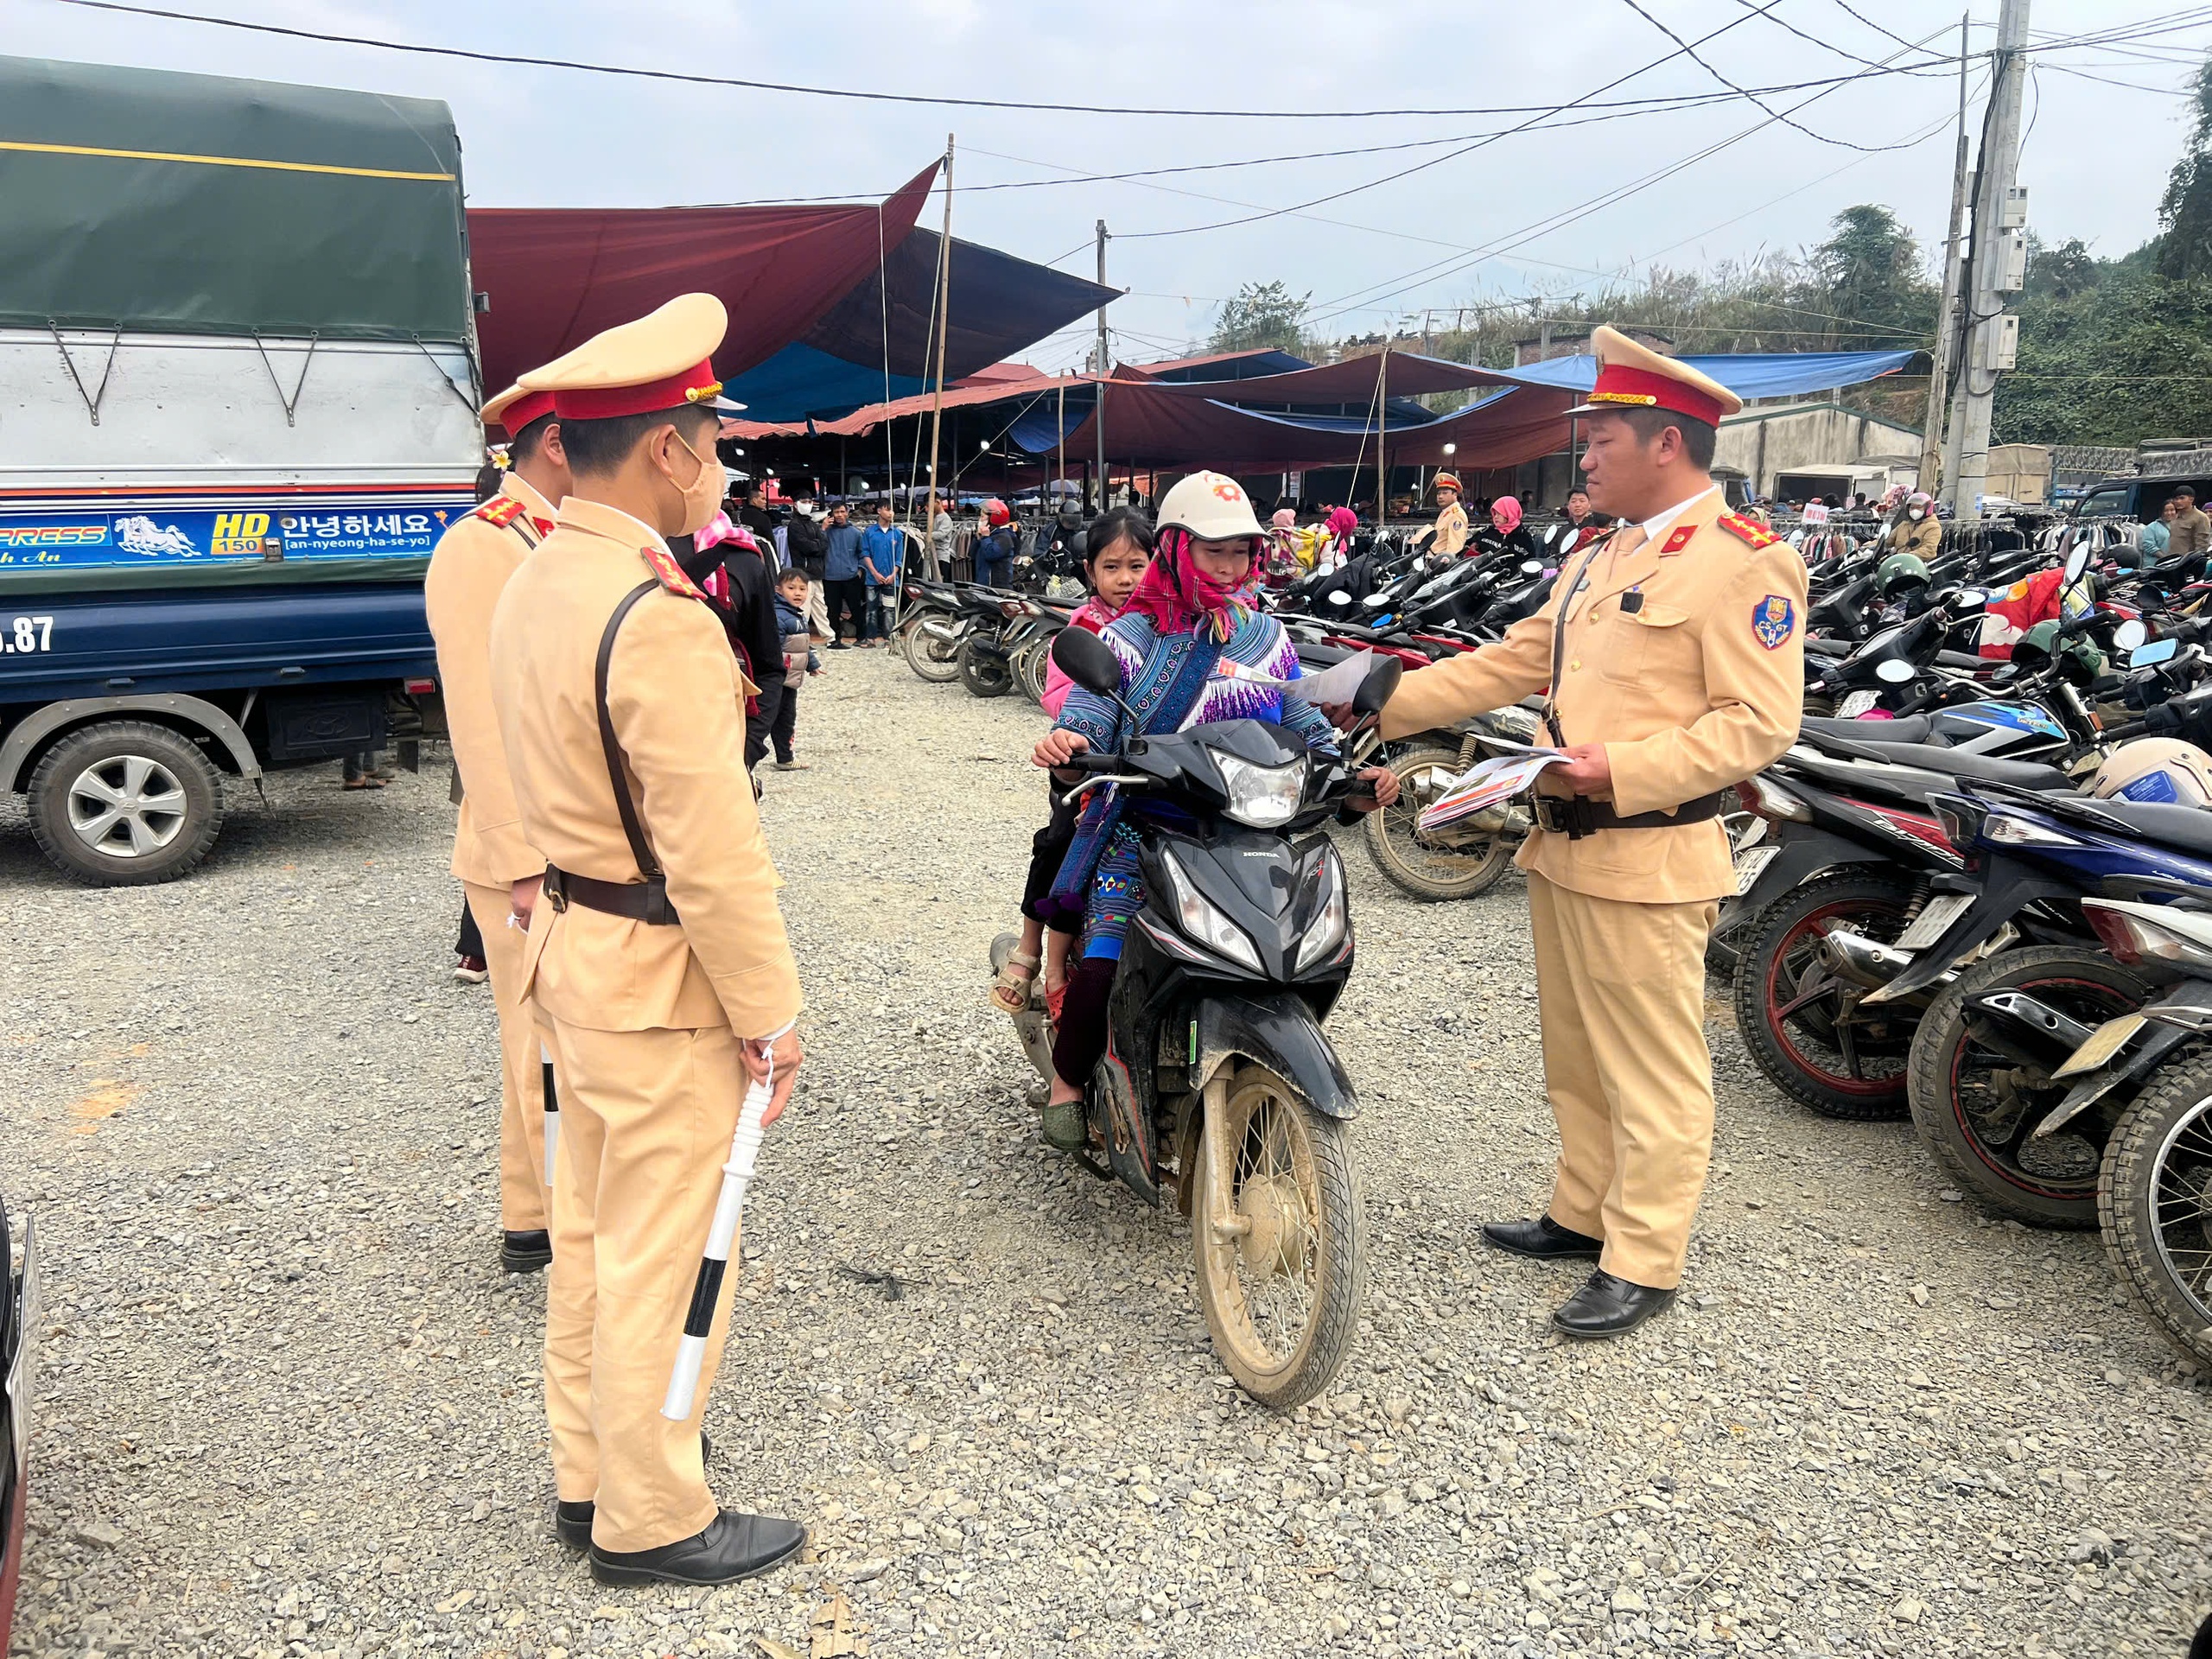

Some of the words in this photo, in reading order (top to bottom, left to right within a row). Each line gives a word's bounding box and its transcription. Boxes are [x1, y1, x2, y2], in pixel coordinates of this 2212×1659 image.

[213, 513, 270, 537] HD
[281, 514, 432, 538] 안녕하세요
[219, 540, 257, 551] 150
[22, 551, 61, 563] An
[0, 616, 54, 653] .87
[1758, 620, 1771, 630] CS
[1776, 623, 1788, 632] GT
